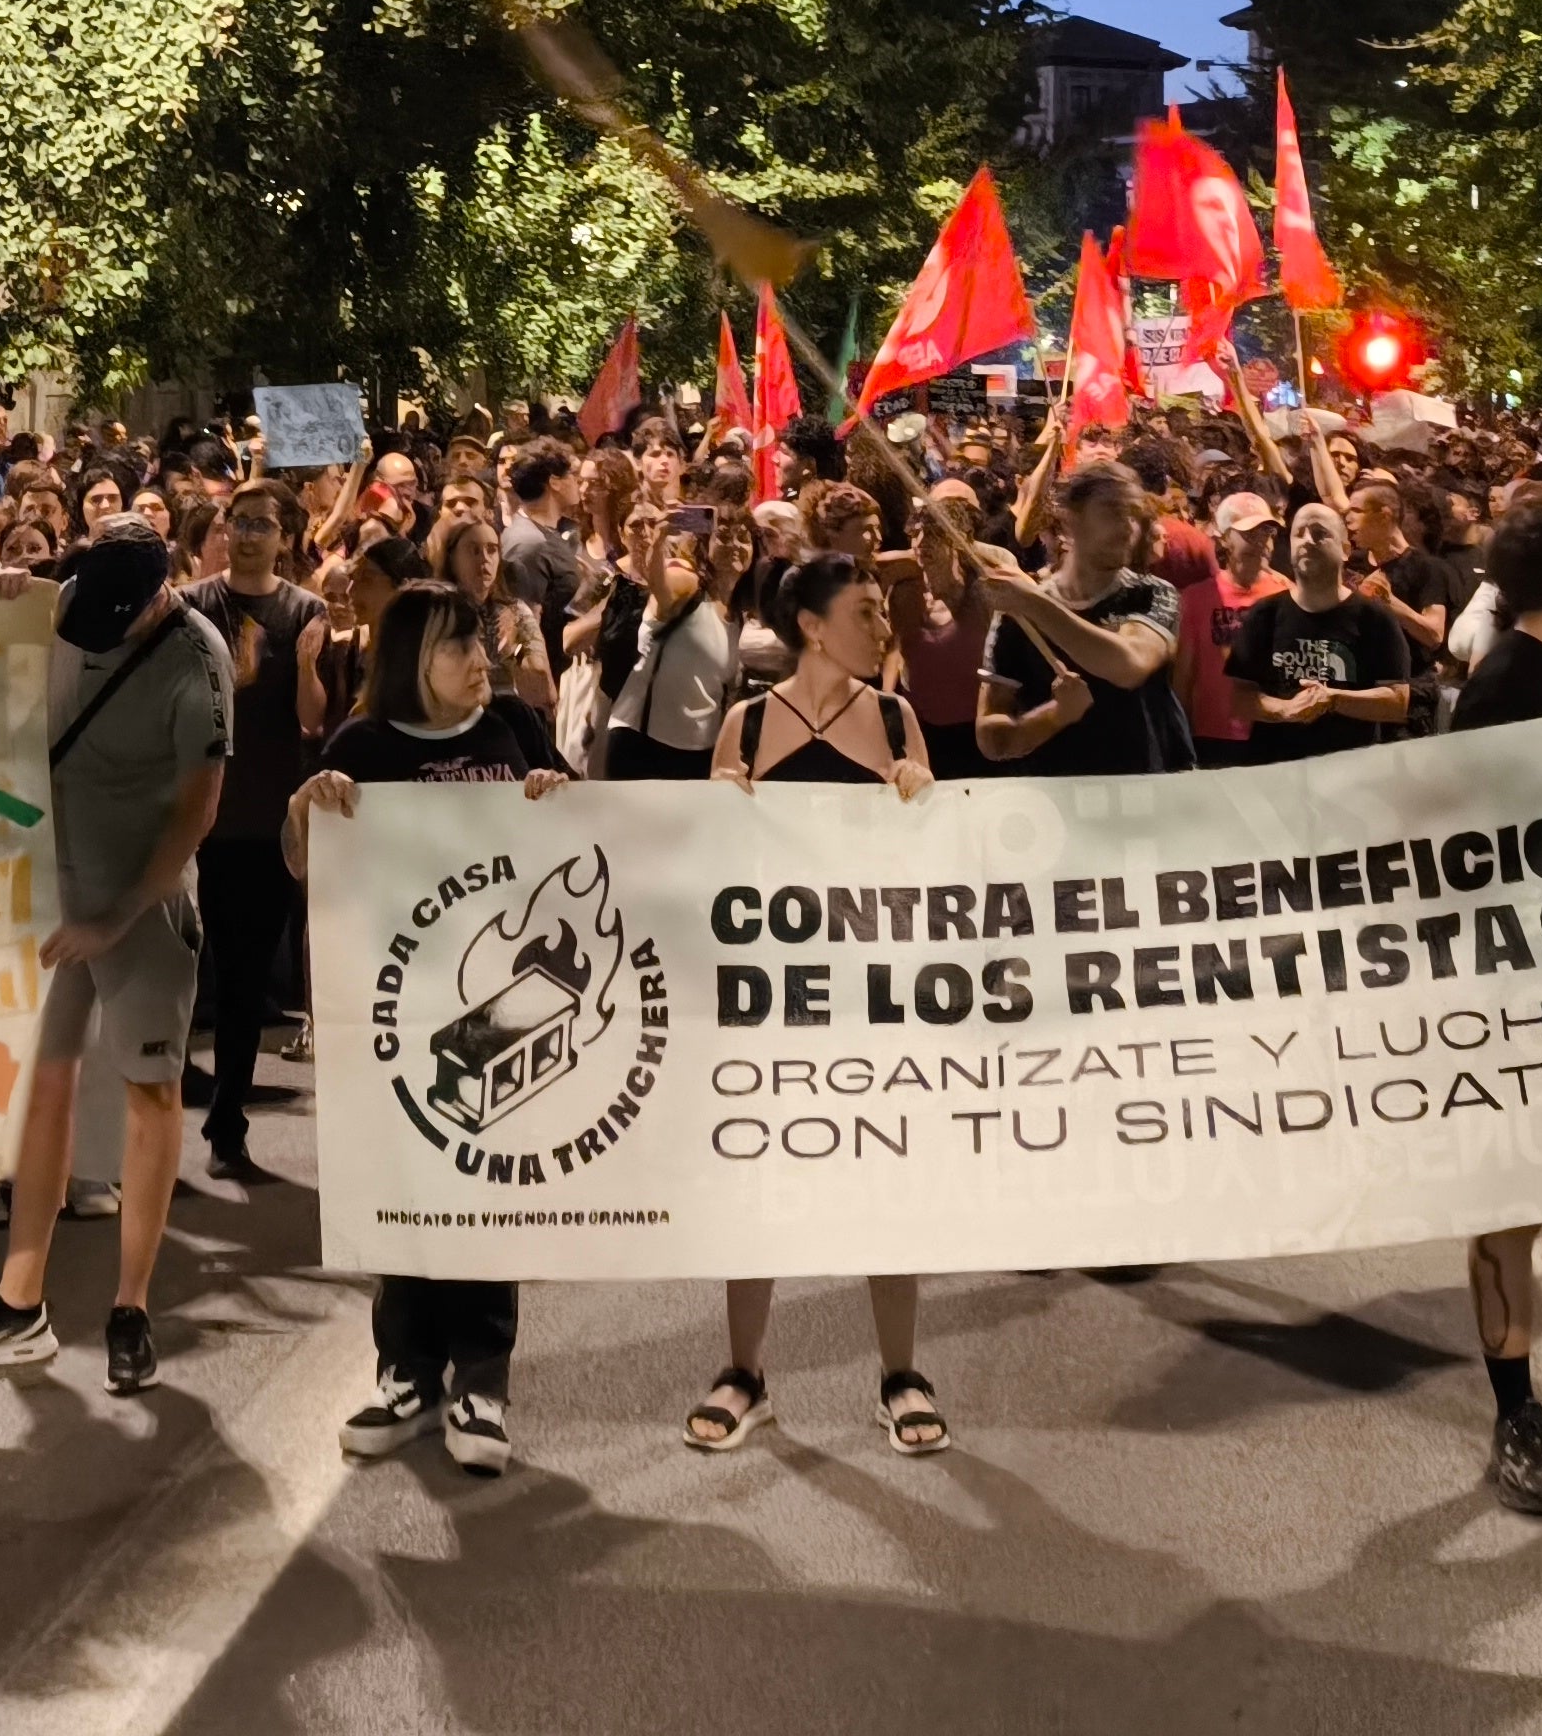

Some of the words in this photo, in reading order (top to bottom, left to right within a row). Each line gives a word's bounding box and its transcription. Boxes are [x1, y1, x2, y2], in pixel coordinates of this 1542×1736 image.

[1272, 650, 1331, 667] SOUTH
[1285, 665, 1331, 681] FACE
[1295, 638, 1330, 652] THE
[710, 881, 1035, 945] CONTRA
[1053, 876, 1140, 933] EL
[373, 933, 419, 1061] CADA
[412, 855, 517, 928] CASA
[717, 964, 830, 1027] DE
[866, 958, 1034, 1024] LOS
[455, 1142, 547, 1185] UNA
[552, 937, 669, 1176] TRINCHERA
[711, 1038, 1216, 1096] ORGANÍZATE
[1250, 1030, 1299, 1068] Y
[711, 1114, 907, 1160] CON
[951, 1105, 1067, 1154] TU
[376, 1209, 452, 1228] SINDICATO
[457, 1213, 476, 1227] DE
[481, 1210, 558, 1227] VIVIENDA
[561, 1210, 585, 1226] DE
[588, 1209, 670, 1227] GRANADA
